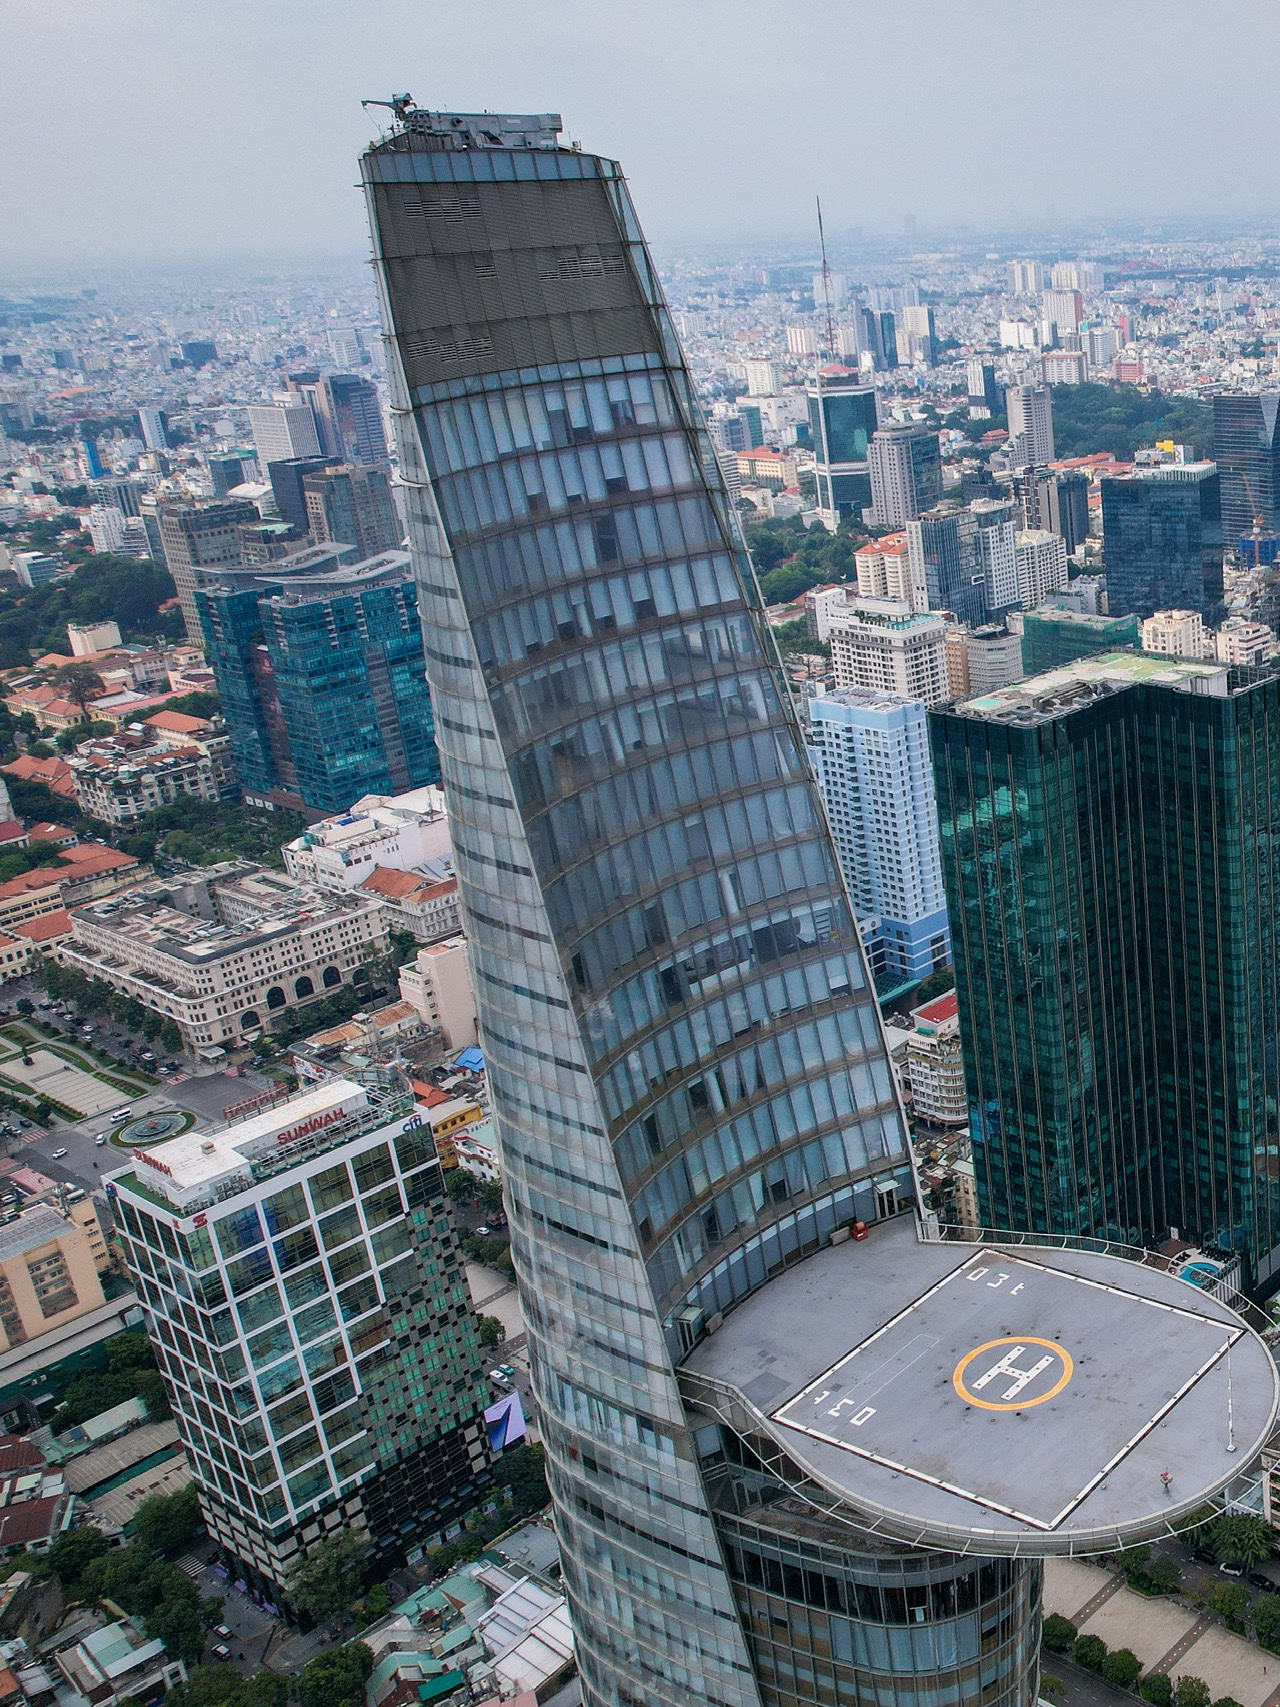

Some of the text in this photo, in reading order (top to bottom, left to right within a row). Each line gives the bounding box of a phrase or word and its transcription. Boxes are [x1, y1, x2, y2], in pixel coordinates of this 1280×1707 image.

[276, 1107, 346, 1146] SUNWAH
[402, 1114, 423, 1133] citi
[971, 1345, 1055, 1401] H
